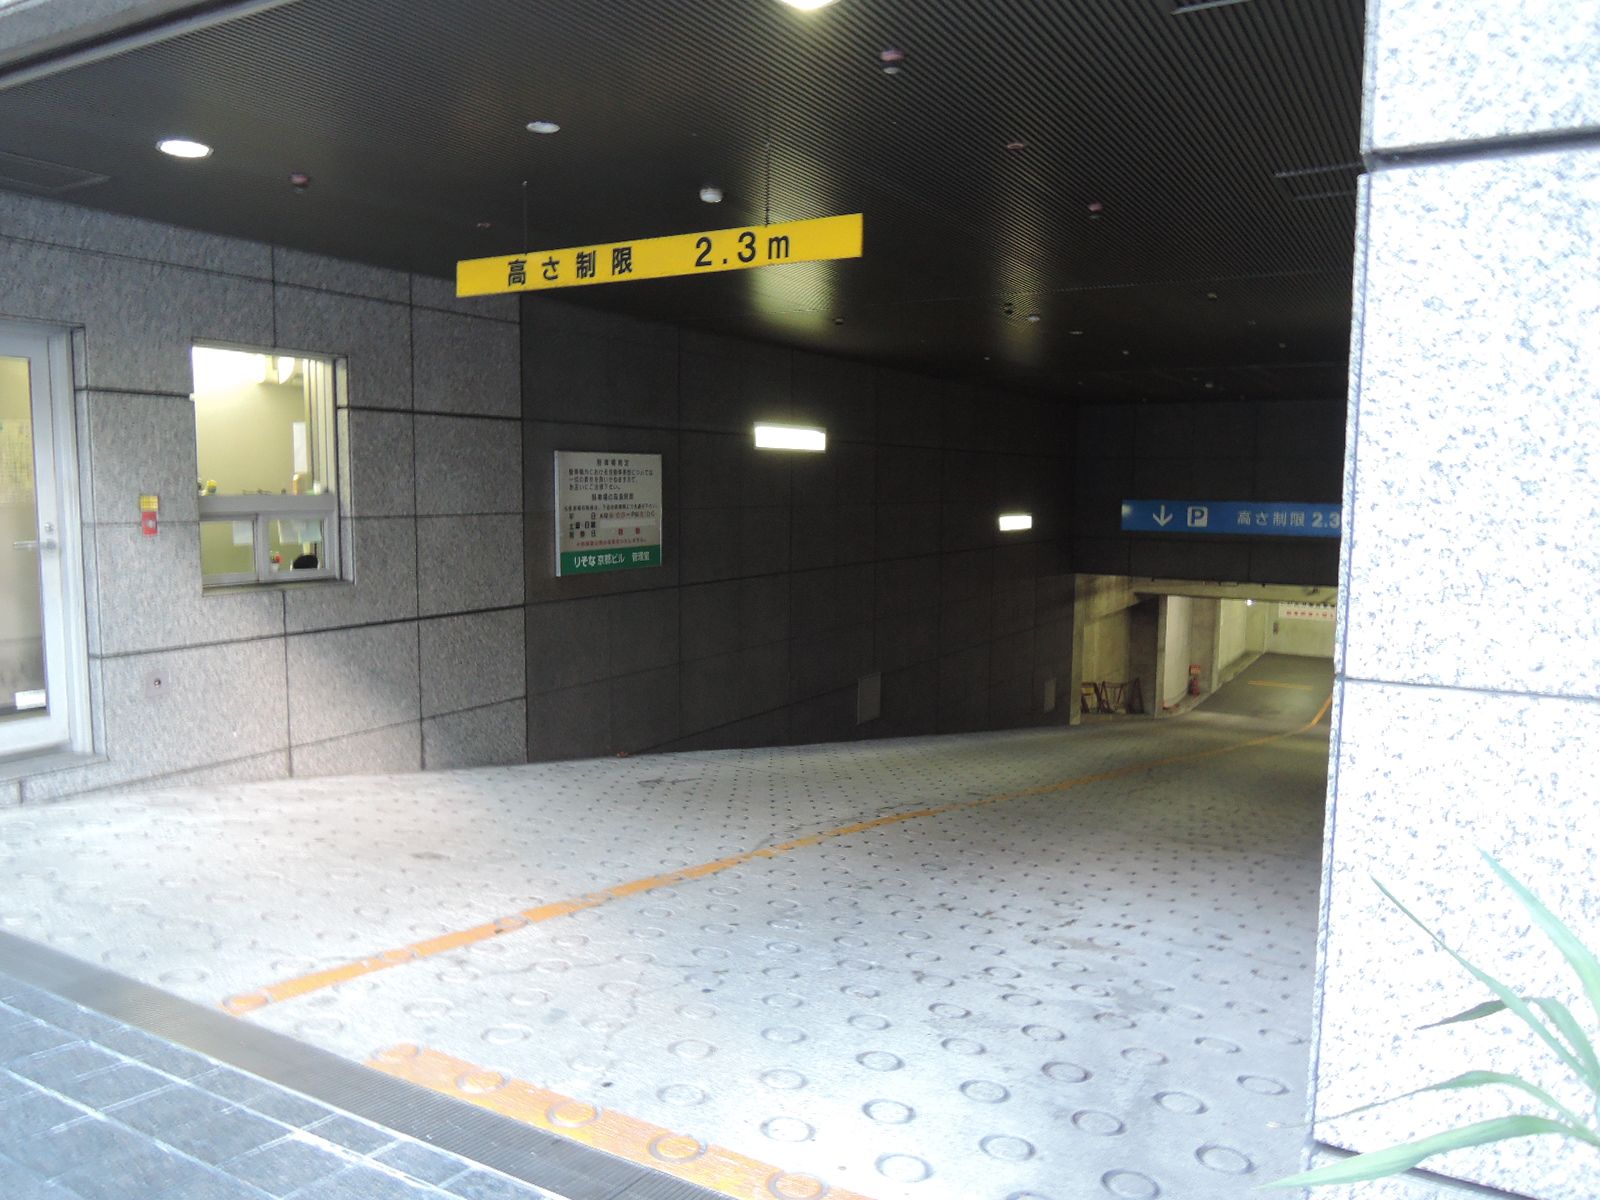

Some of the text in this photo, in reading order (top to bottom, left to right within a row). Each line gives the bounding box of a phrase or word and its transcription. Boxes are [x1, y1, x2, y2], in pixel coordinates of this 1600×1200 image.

[508, 231, 790, 286] 高さ制限 2.3m
[1190, 508, 1206, 526] P
[1237, 511, 1305, 527] 高さ制限
